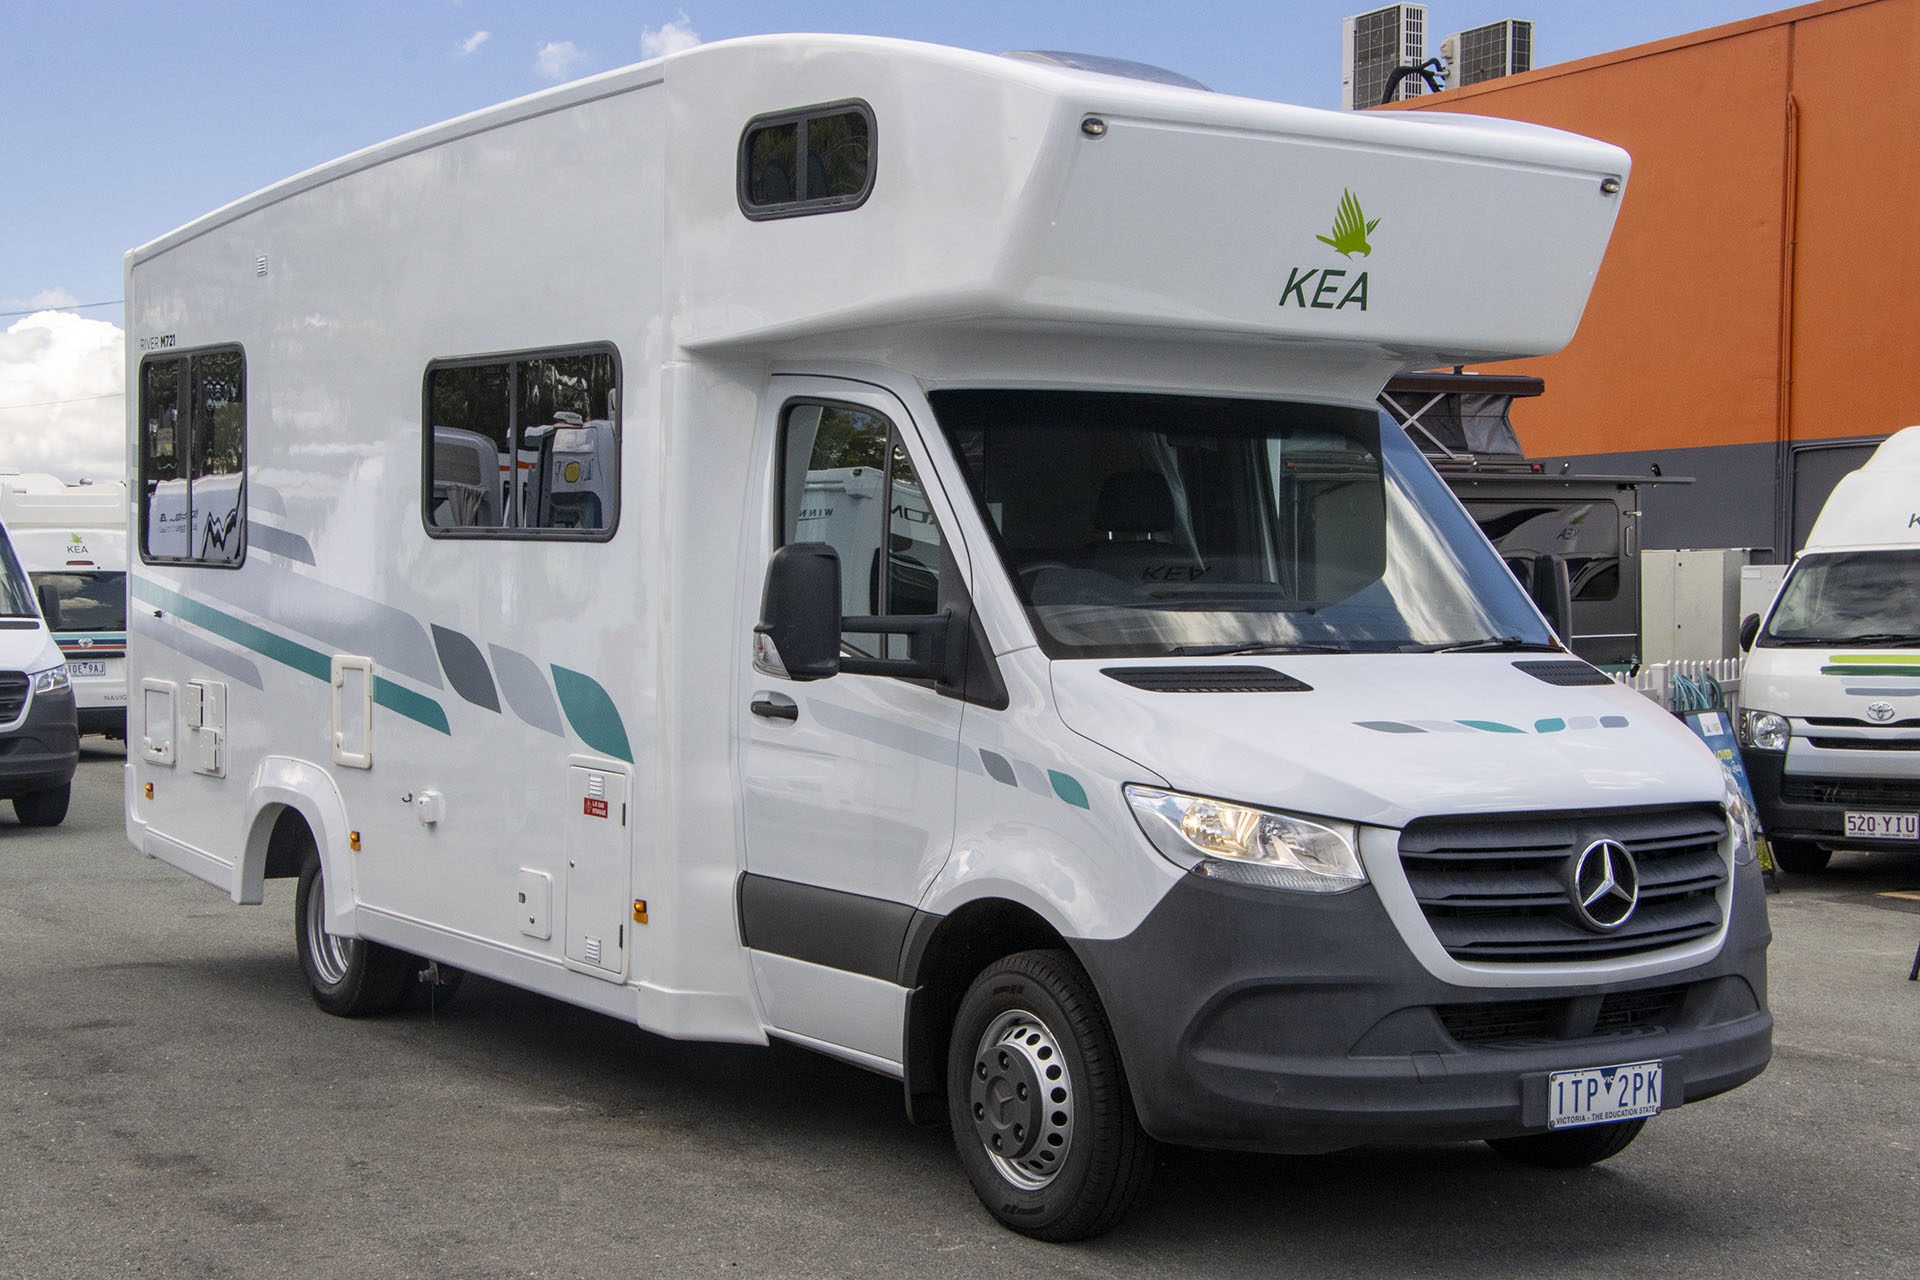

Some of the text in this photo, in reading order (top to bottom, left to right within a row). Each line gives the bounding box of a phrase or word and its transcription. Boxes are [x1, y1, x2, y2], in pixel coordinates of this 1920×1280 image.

[1279, 267, 1368, 311] KEA
[140, 334, 176, 351] RIVER M721
[67, 545, 89, 554] KEA
[1847, 815, 1916, 833] 520 YIU
[1557, 1078, 1598, 1115] 1TP
[1618, 1070, 1658, 1108] 2PK
[1556, 1114, 1586, 1125] VICTORIA
[1592, 1112, 1603, 1120] THE
[1605, 1108, 1638, 1119] EDUCATION
[1639, 1105, 1656, 1114] STATE
